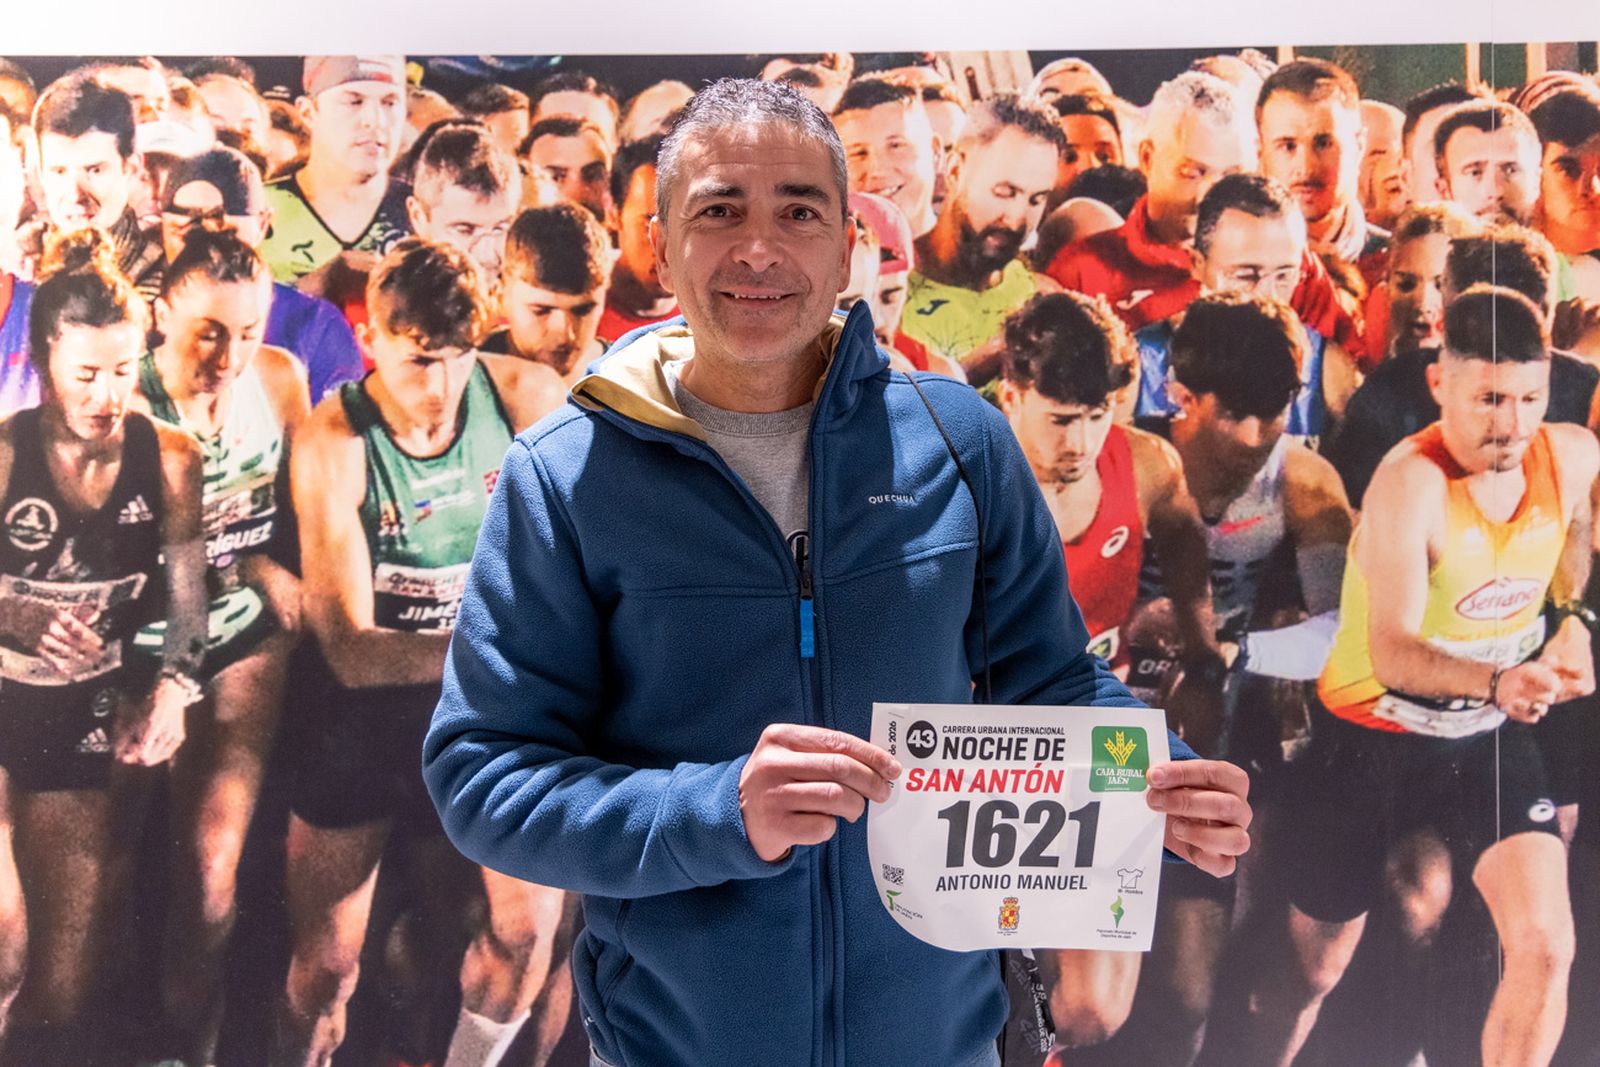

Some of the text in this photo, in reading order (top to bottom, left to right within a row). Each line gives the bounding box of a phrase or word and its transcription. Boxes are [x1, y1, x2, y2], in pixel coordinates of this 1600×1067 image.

[868, 494, 916, 505] QUECHUA
[888, 721, 897, 743] 2026
[907, 729, 936, 749] 43
[942, 725, 1065, 736] CARRERA URBANA INTERNACIONAL
[942, 736, 1066, 762] NOCHE DE
[905, 763, 1065, 794] SAN ANTÓN
[1095, 767, 1145, 778] CAJA RURAL
[937, 799, 1101, 868] 1621
[935, 873, 1088, 892] ANTONIO MANUEL
